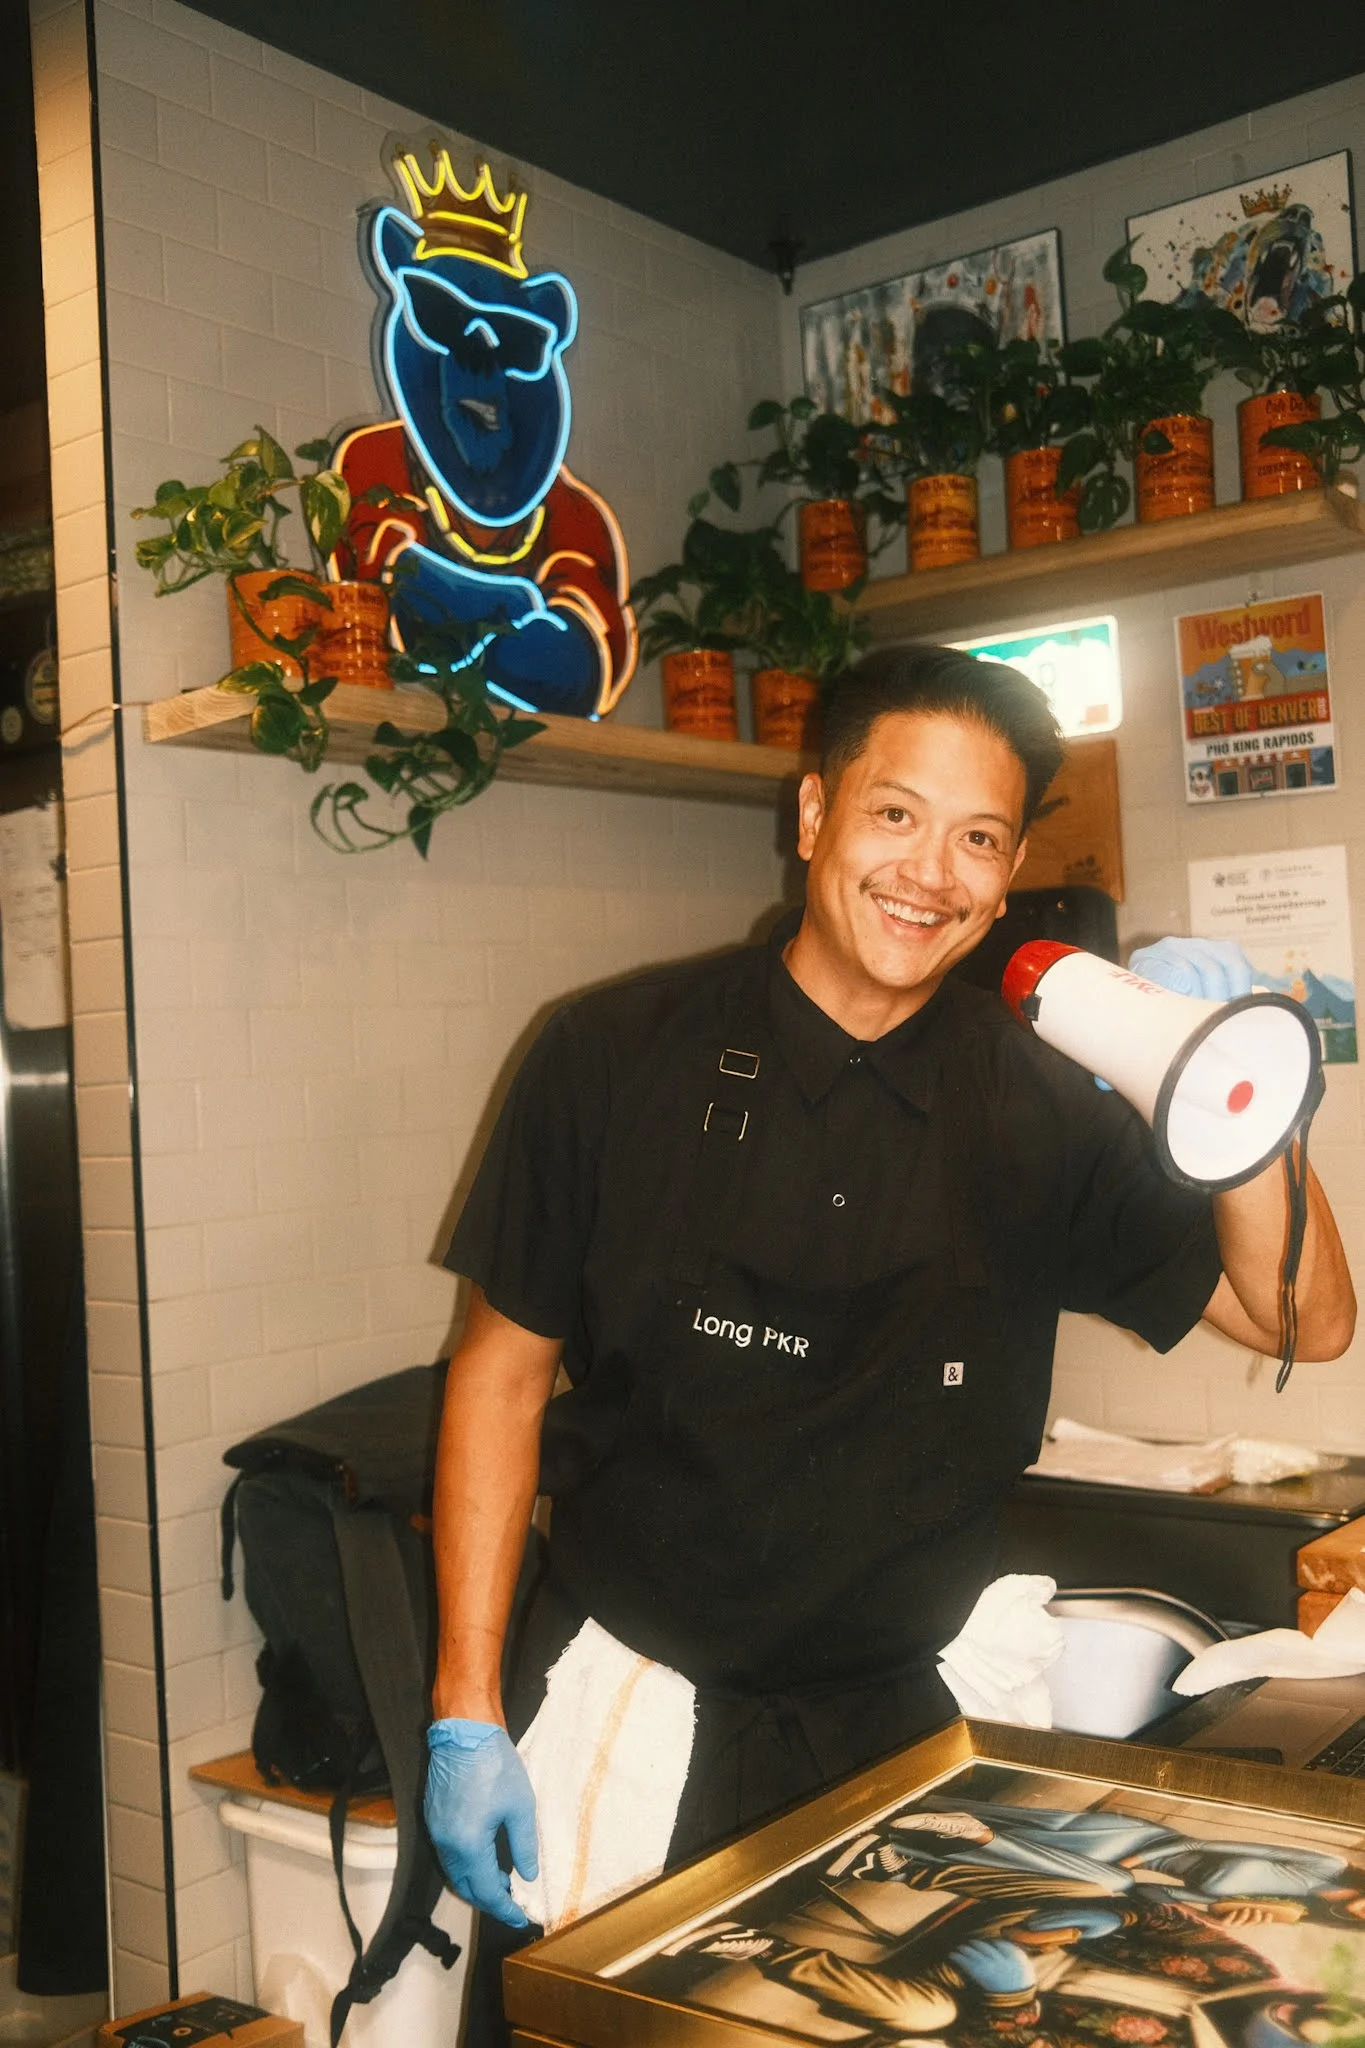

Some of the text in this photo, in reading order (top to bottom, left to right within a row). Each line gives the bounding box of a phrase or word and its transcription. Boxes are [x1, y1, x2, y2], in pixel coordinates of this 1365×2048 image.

[1196, 604, 1311, 648] Westword
[1193, 709, 1229, 736] BEST
[1235, 705, 1254, 730] OF
[1258, 699, 1319, 727] DENVER
[1233, 738, 1260, 753] KING
[1264, 731, 1315, 749] RAPIDOS
[693, 1308, 810, 1358] Long PKR
